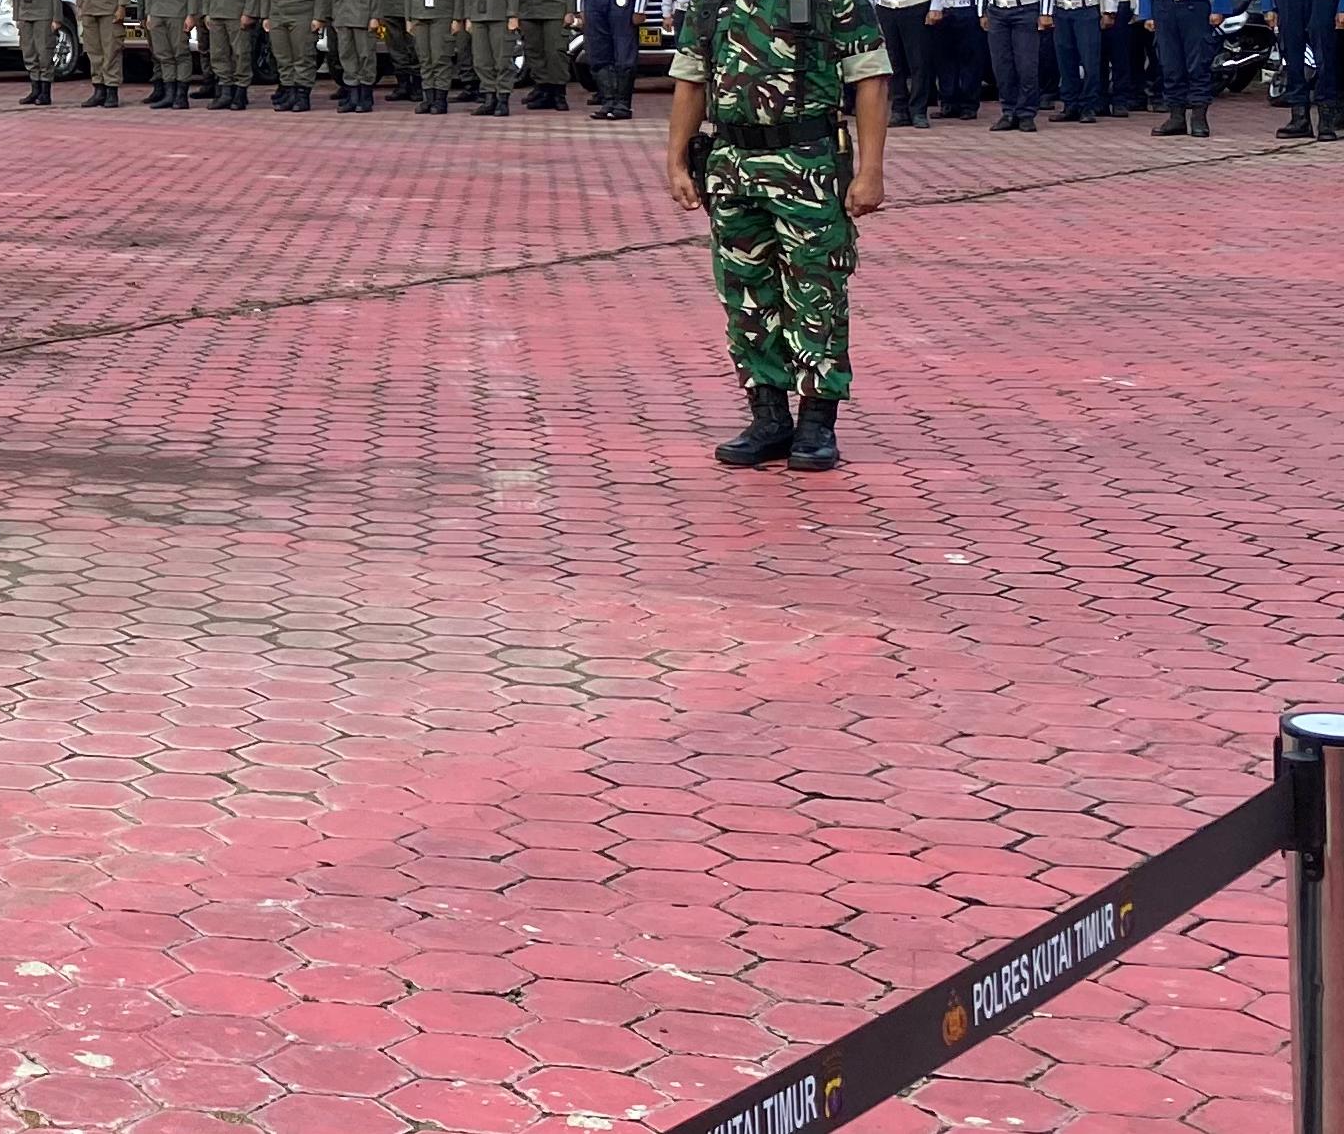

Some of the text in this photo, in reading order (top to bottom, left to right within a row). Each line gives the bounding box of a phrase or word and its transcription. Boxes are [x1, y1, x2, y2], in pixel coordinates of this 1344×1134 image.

[972, 902, 1116, 1027] POLRES KUTAI TIMUR
[763, 1074, 818, 1134] TIMUR
